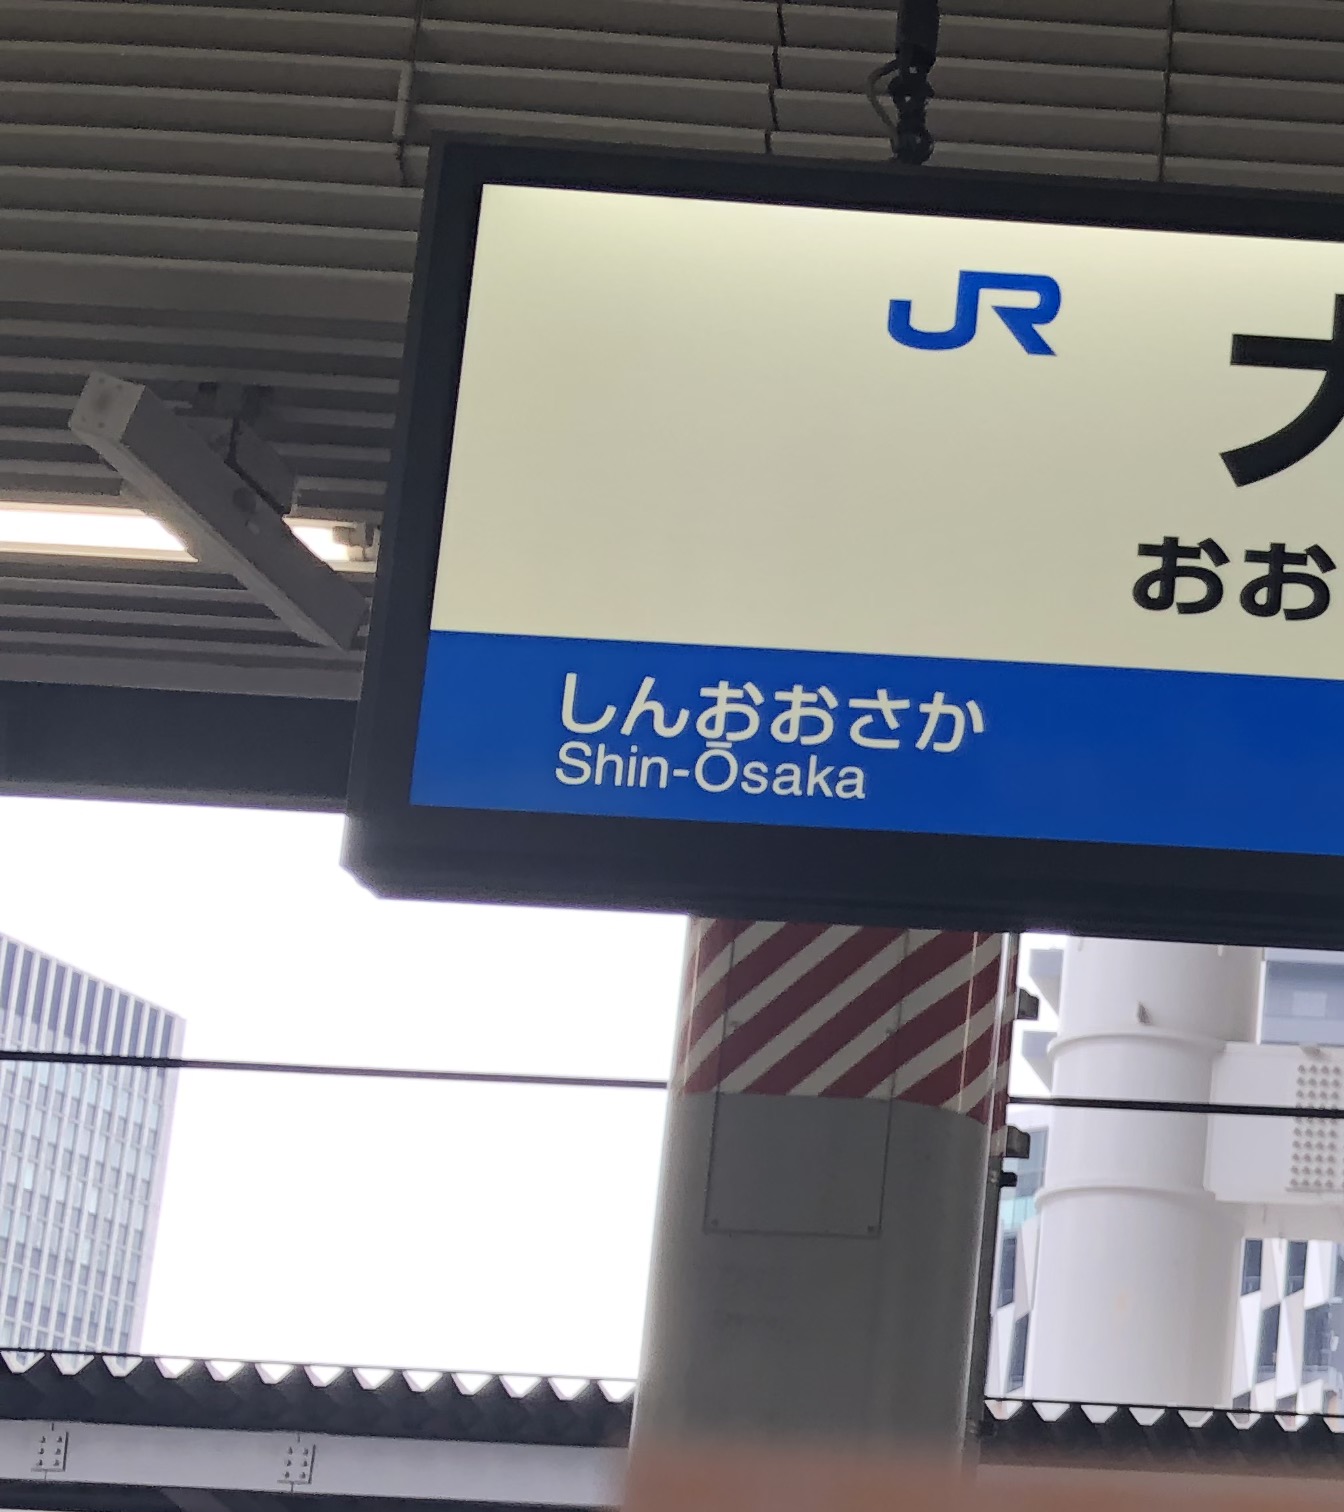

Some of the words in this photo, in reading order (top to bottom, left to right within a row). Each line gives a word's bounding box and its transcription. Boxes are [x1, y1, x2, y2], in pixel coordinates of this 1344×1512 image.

[886, 269, 1063, 358] JR
[560, 672, 986, 755] しんおおさか
